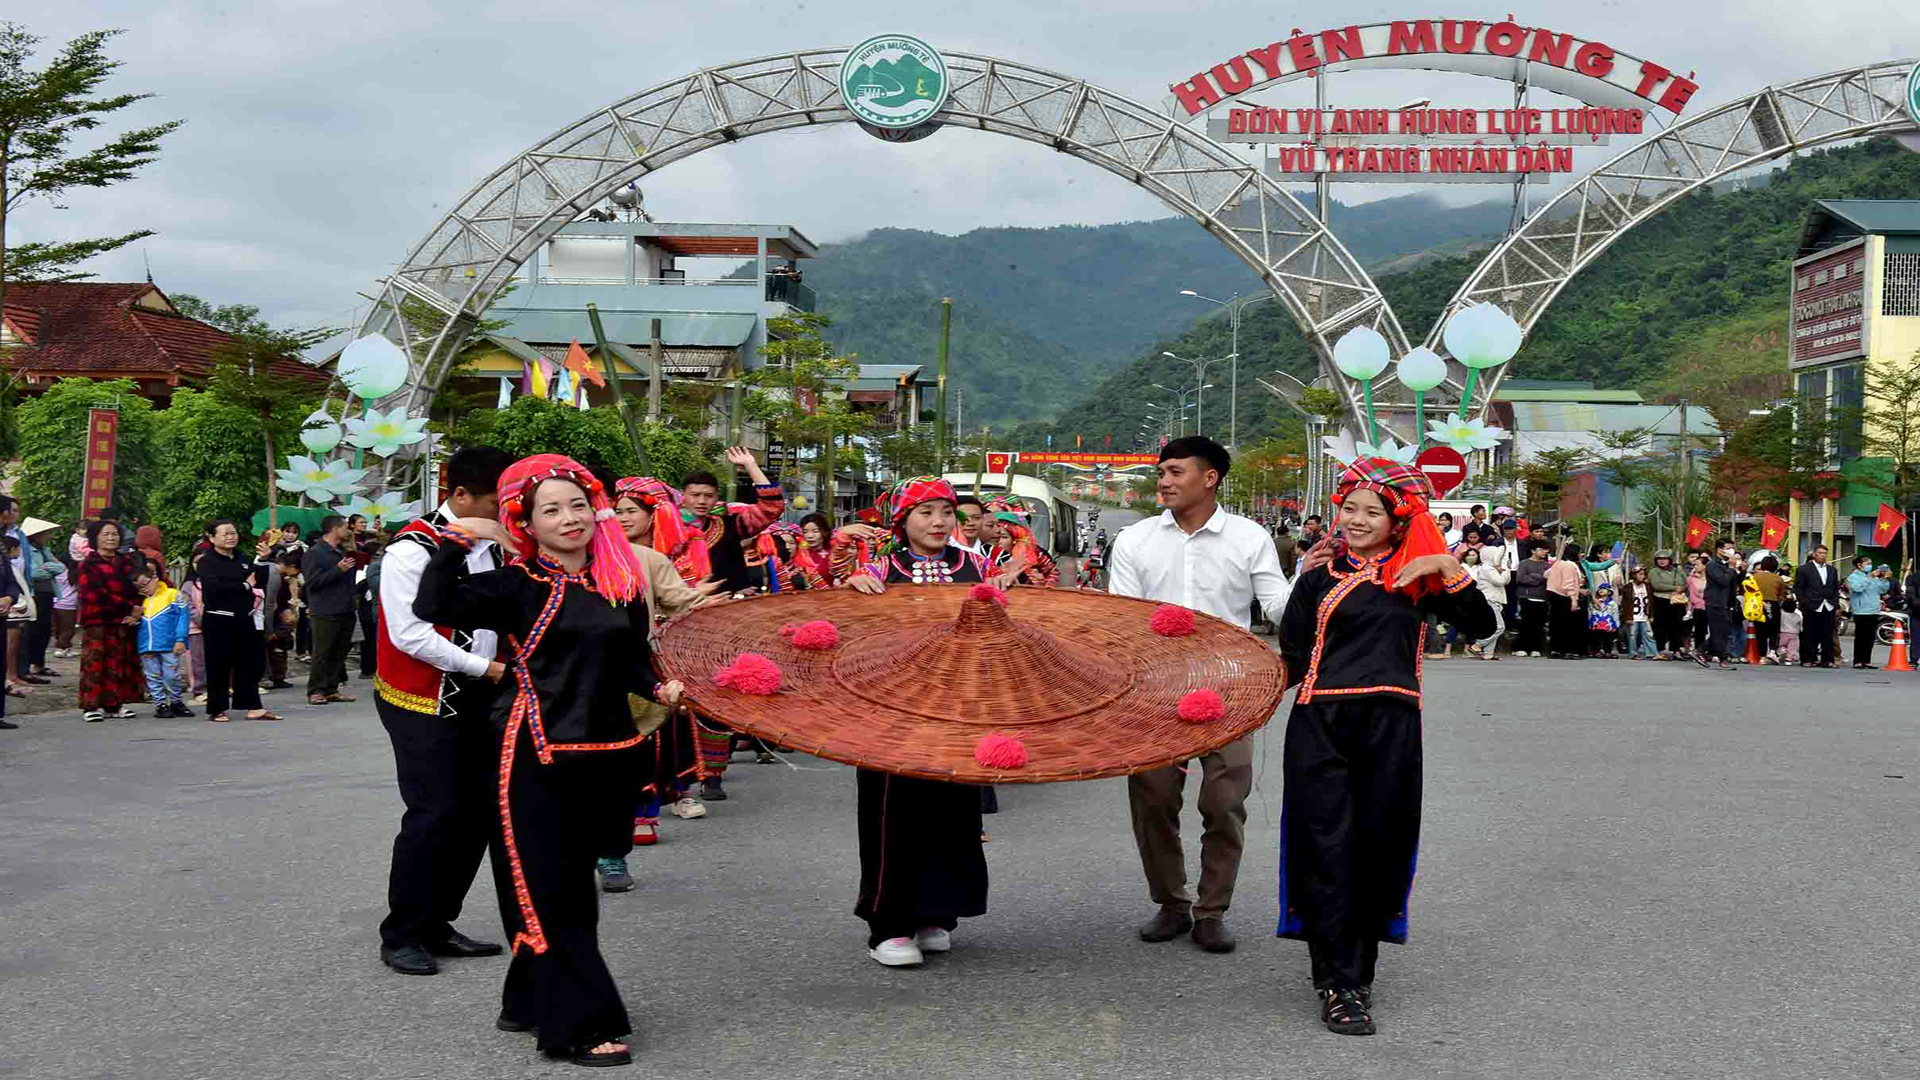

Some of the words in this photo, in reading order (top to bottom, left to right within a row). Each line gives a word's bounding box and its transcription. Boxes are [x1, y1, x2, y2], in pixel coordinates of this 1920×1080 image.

[1172, 26, 1365, 116] HUYỆN
[1387, 14, 1615, 78] MƯỜNG
[1634, 60, 1699, 115] TÈ
[1229, 107, 1289, 134] ĐƠN
[1297, 108, 1323, 141] VỊ
[1331, 108, 1389, 134] ANH
[1399, 102, 1477, 134] HÙNG
[1488, 106, 1542, 142] LỰC
[1552, 106, 1644, 142] LƯỢNG
[1279, 141, 1315, 173] VŨ
[1325, 147, 1421, 173] TRANG
[1430, 139, 1508, 173] NHÂN
[1516, 140, 1573, 173] DÂN
